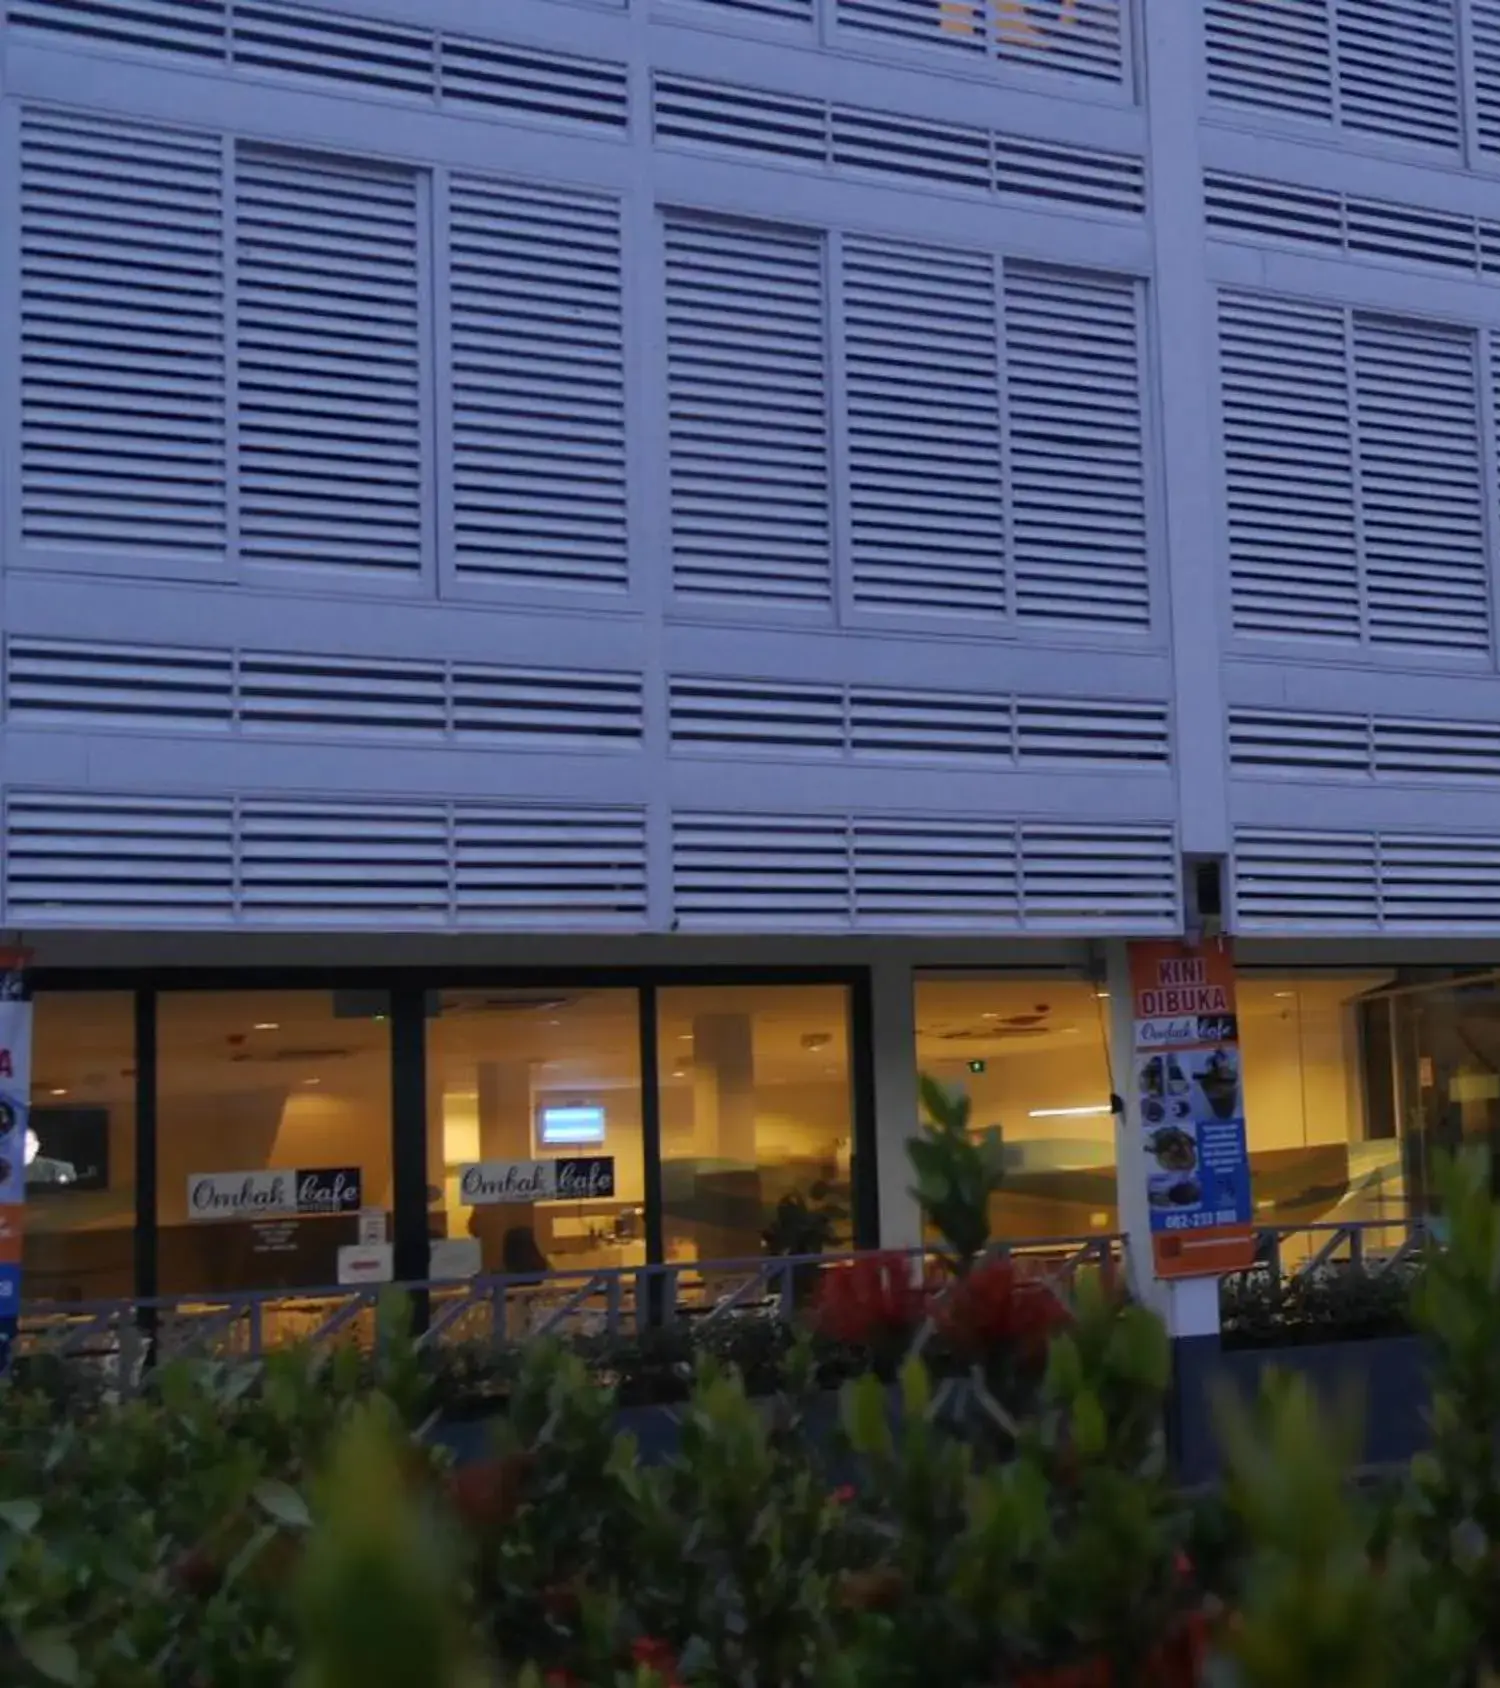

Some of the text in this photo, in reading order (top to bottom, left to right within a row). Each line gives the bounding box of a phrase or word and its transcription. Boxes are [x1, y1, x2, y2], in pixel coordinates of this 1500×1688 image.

[1159, 959, 1205, 984] KINI
[1141, 987, 1226, 1015] DIBUKA
[192, 1173, 358, 1211] Ombak Cafe
[462, 1161, 612, 1196] Ombak Cafe
